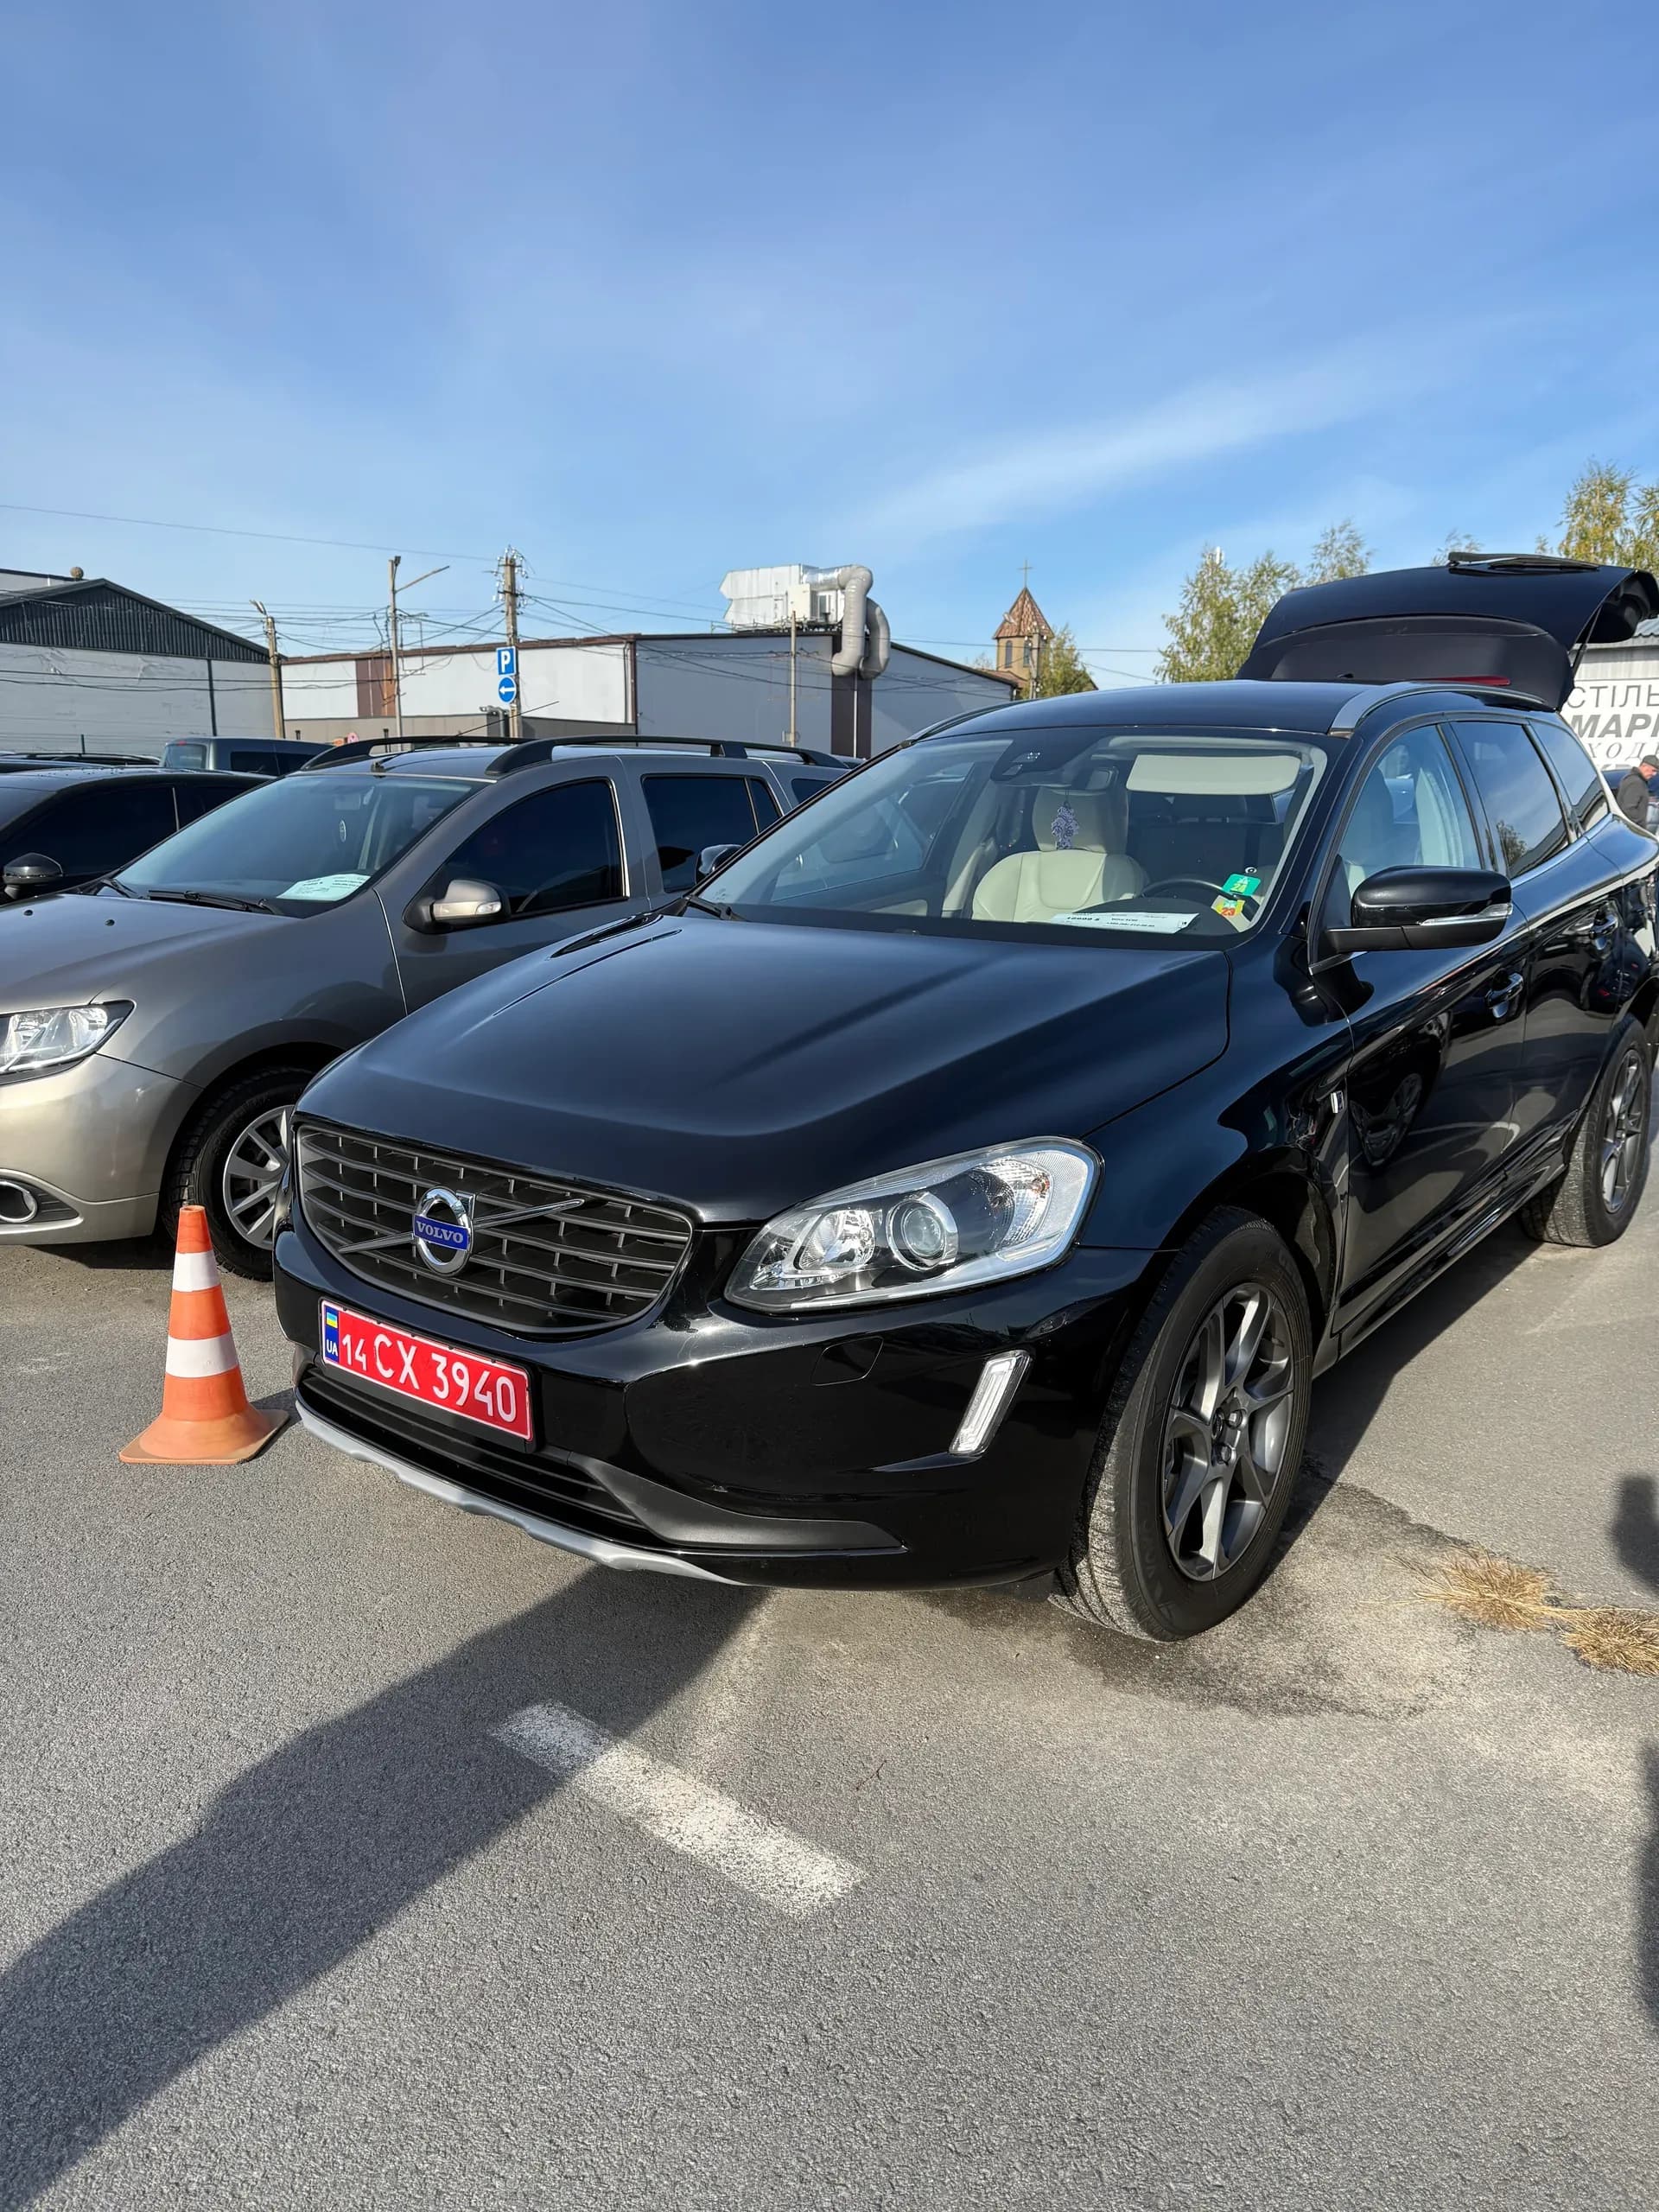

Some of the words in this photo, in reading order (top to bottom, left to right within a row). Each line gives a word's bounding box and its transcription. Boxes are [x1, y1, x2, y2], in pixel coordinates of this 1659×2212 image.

[501, 650, 512, 673] P
[416, 1220, 465, 1244] VOLVO
[325, 1339, 339, 1357] UA
[431, 1351, 517, 1423] 3940
